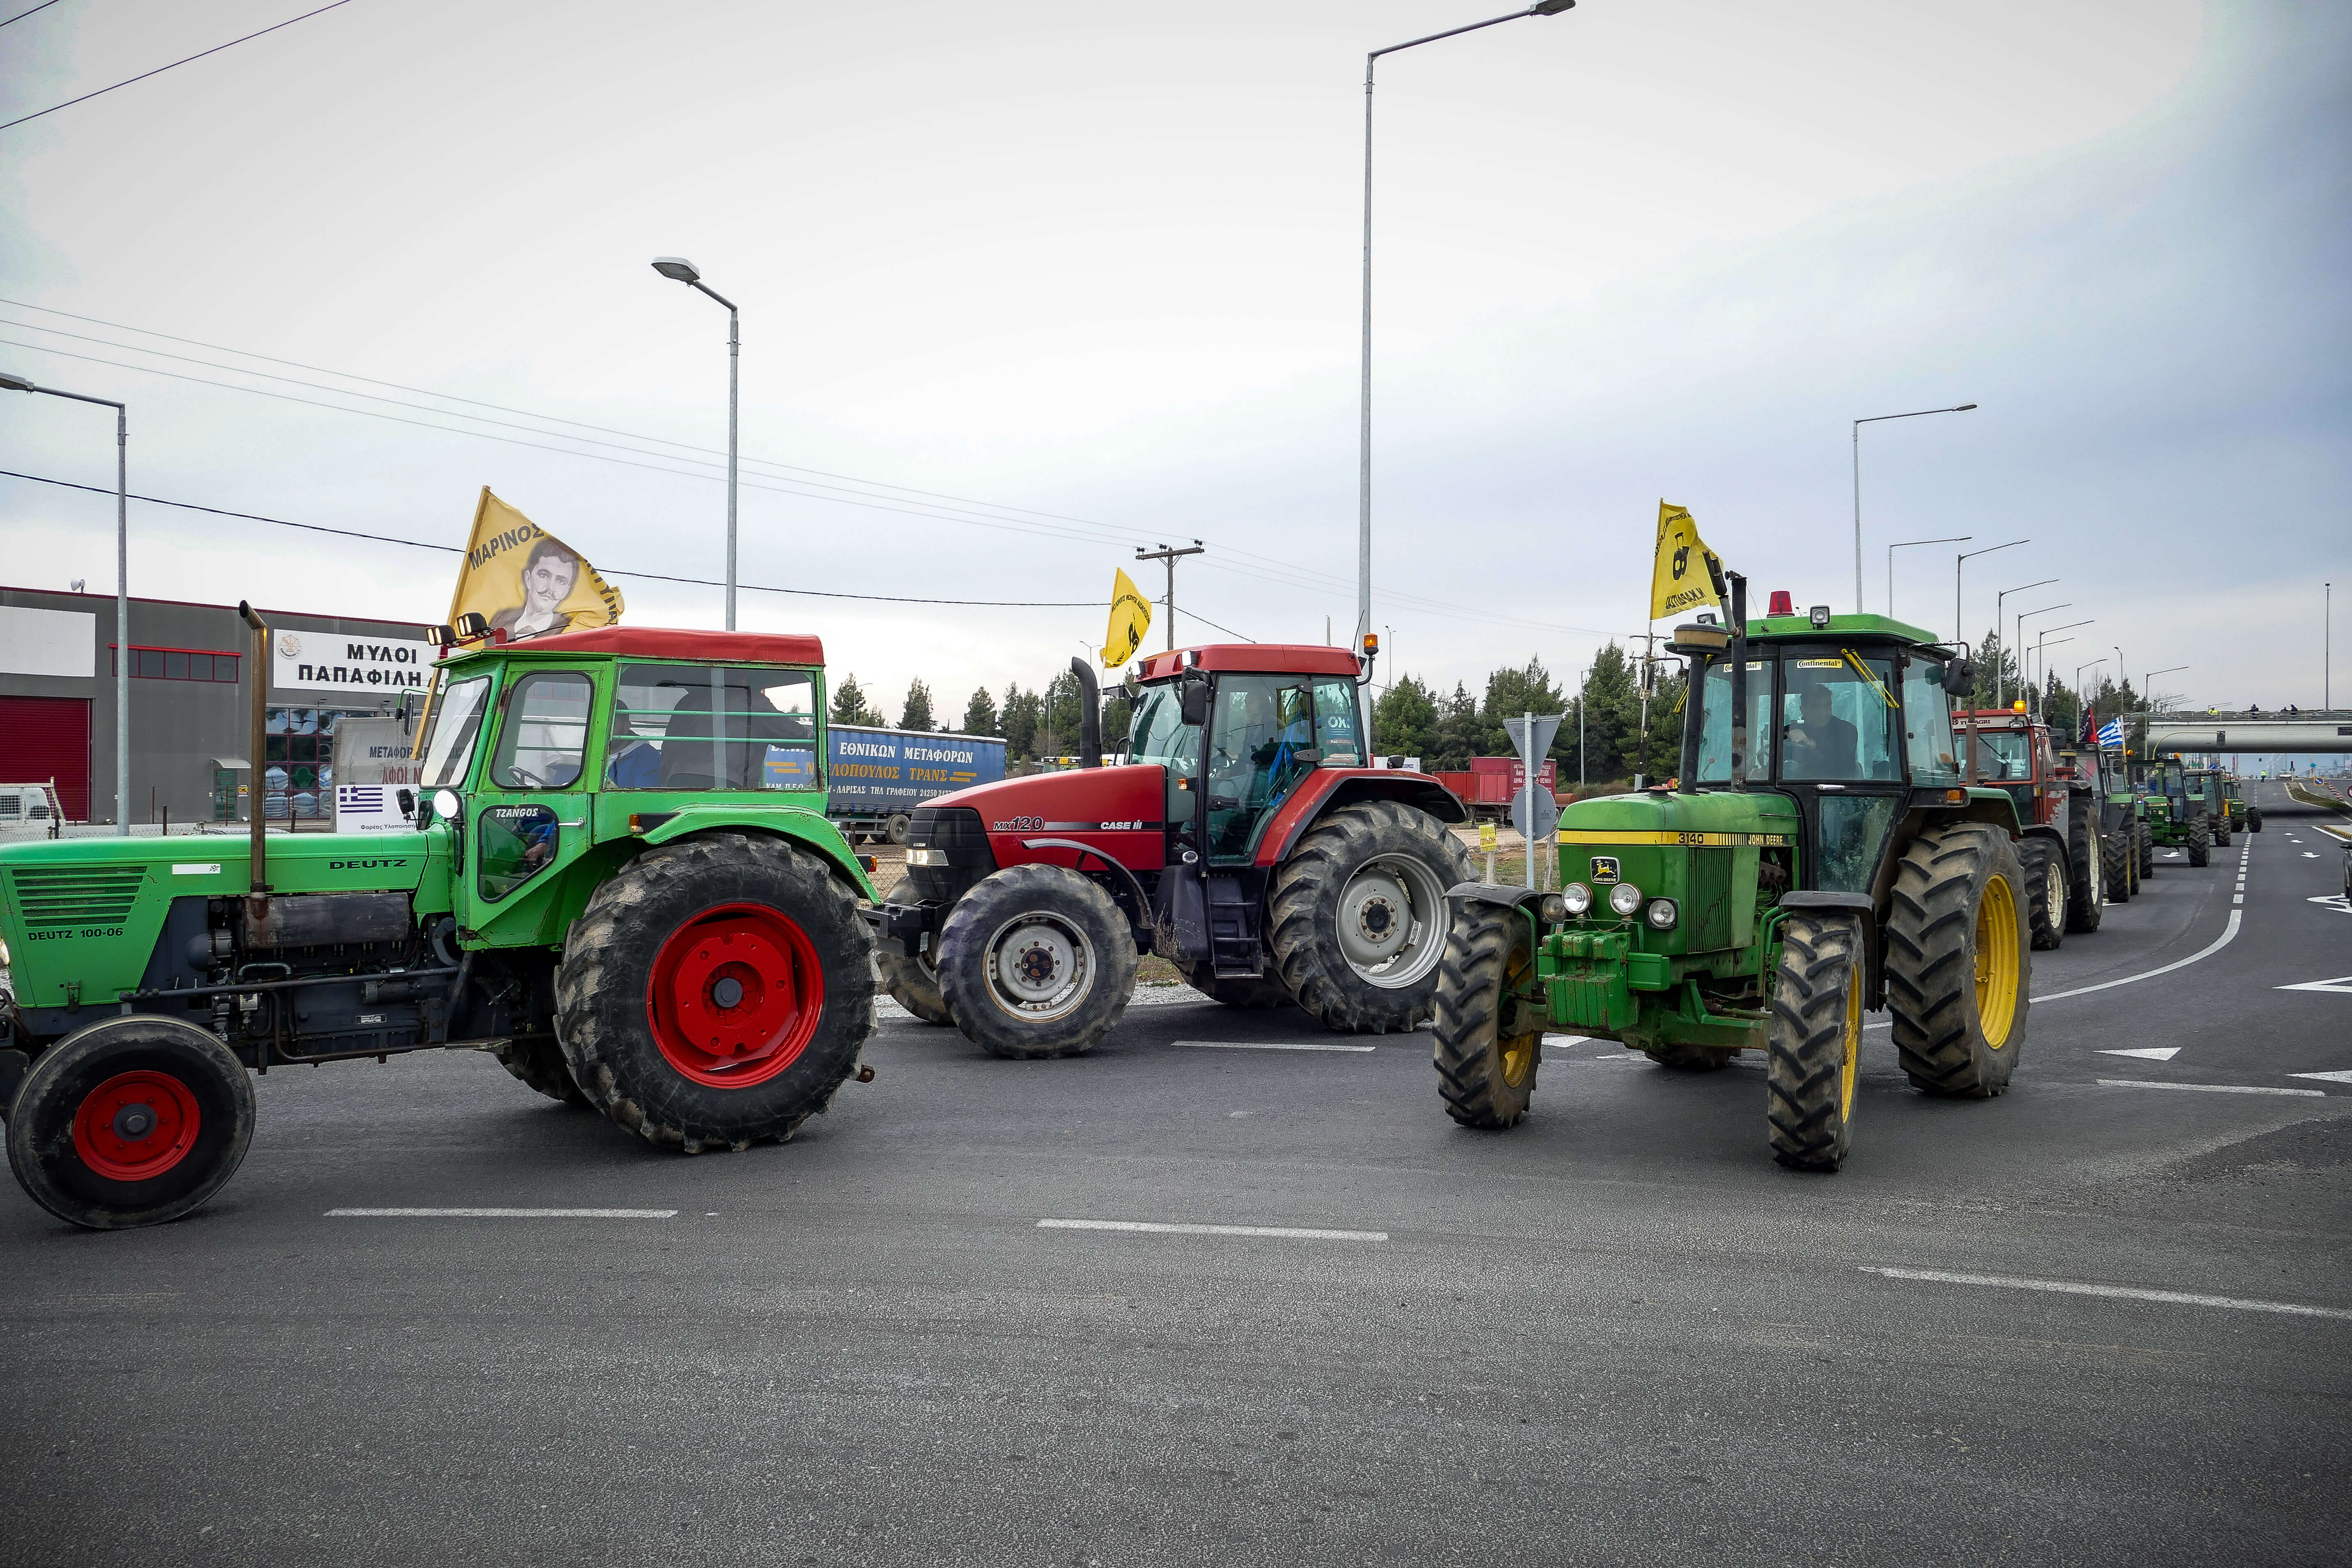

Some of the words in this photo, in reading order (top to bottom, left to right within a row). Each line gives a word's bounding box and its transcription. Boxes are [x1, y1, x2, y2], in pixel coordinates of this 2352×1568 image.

[468, 523, 544, 571] ΜΑΡΙΝΟΣ
[347, 643, 417, 664] ΜΥΛΟΙ
[298, 664, 421, 687] ΠΑΠΑΦΙΛΗ
[840, 742, 896, 758] ΕΘΝΙΚΩΝ
[904, 747, 973, 764] ΜΕΤΑΦΟΡΩΝ
[910, 767, 948, 782] ΤΡΑΝΣ
[870, 786, 883, 794] ΤΗΛ
[886, 787, 917, 797] ΓΡΑΦΕΙΟΥ
[920, 789, 937, 797] 24250
[496, 808, 539, 817] TZANGOS
[993, 816, 1045, 831] MX120
[1100, 822, 1131, 830] CASE
[1678, 833, 1705, 844] 3140
[1748, 834, 1764, 845] JOHN
[1766, 835, 1783, 846] DEERE
[329, 859, 407, 870] DEUTZ
[28, 930, 73, 941] DEUTZ
[80, 928, 123, 938] 100-06
